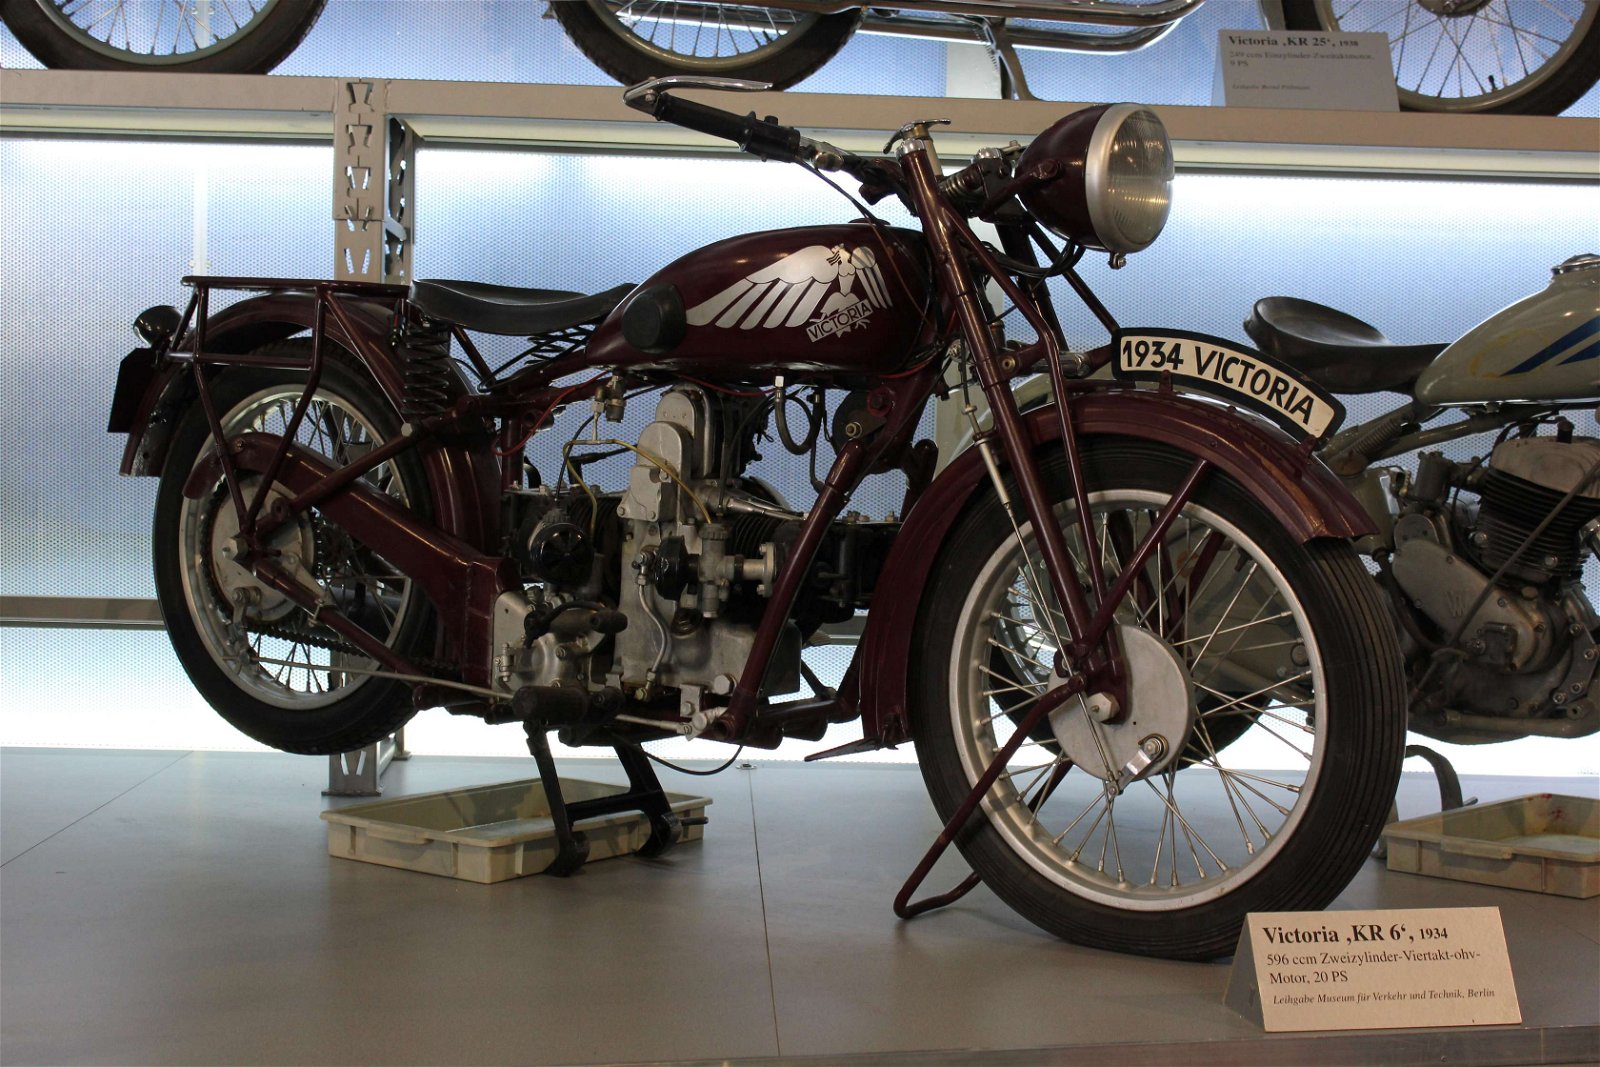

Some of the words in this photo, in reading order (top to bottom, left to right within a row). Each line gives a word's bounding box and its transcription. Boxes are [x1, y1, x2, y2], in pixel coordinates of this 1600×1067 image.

[1228, 35, 1278, 46] Victoria
[808, 302, 871, 339] VICTORIA
[1122, 340, 1184, 370] 1934
[1194, 346, 1315, 425] VICTORIA
[1262, 926, 1339, 944] Victoria
[1419, 927, 1448, 939] 1934
[1266, 954, 1290, 966] 596
[1292, 954, 1317, 965] ccm
[1269, 972, 1311, 985] Motor,
[1314, 971, 1329, 983] 20
[1331, 970, 1348, 982] PS
[1273, 994, 1315, 1005] Leihgabe
[1317, 993, 1355, 1003] Museum
[1356, 992, 1370, 1004] für
[1372, 991, 1408, 1001] Verkehr
[1409, 990, 1427, 1000] und
[1428, 989, 1465, 1000] Technik,
[1467, 988, 1495, 998] Berlin
